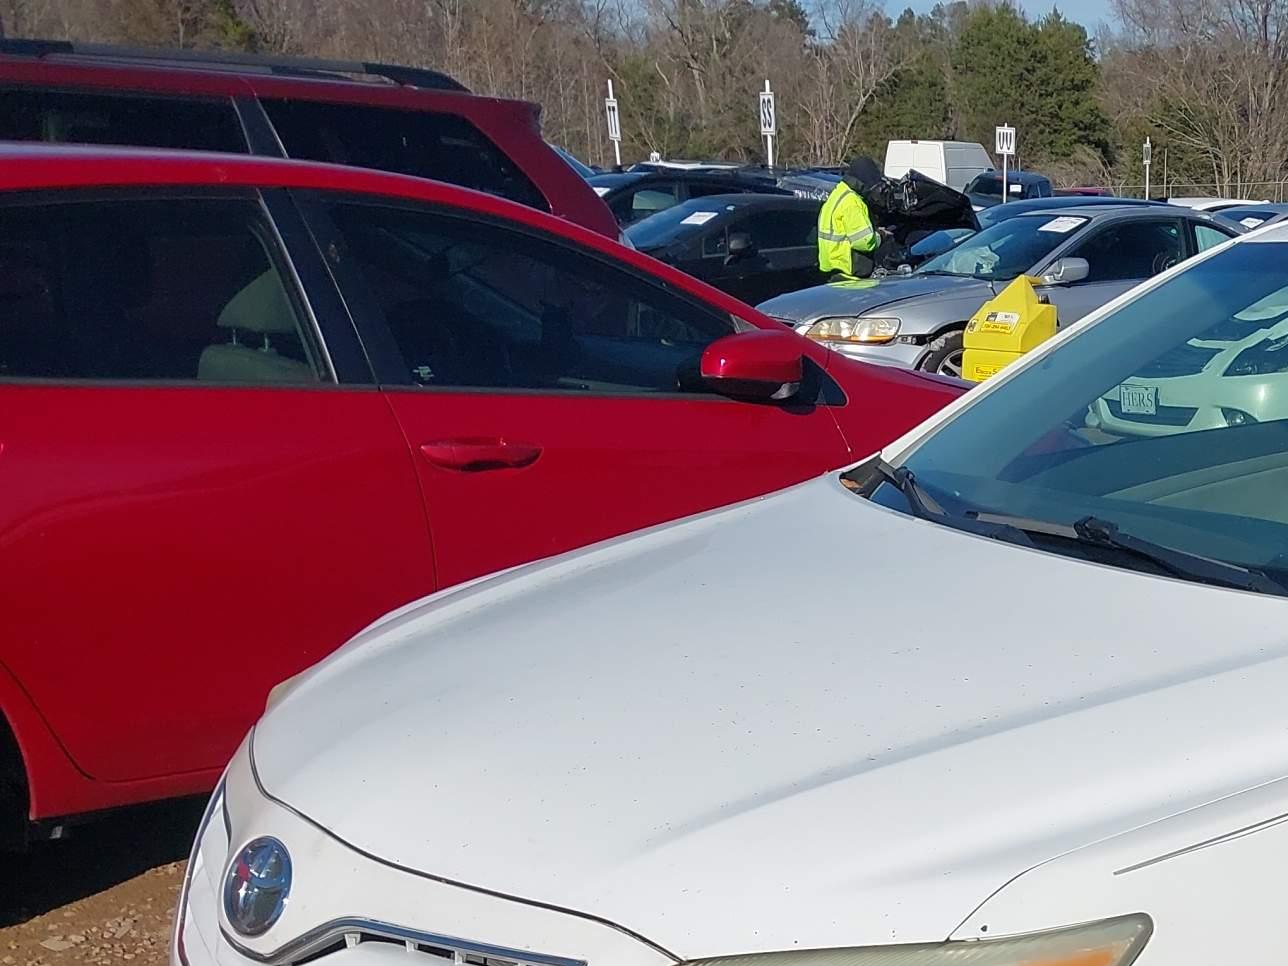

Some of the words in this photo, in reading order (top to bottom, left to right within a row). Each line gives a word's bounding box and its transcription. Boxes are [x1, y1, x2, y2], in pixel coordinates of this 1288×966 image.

[608, 105, 617, 134] TT
[762, 97, 772, 128] SS
[1122, 391, 1154, 407] HERS
